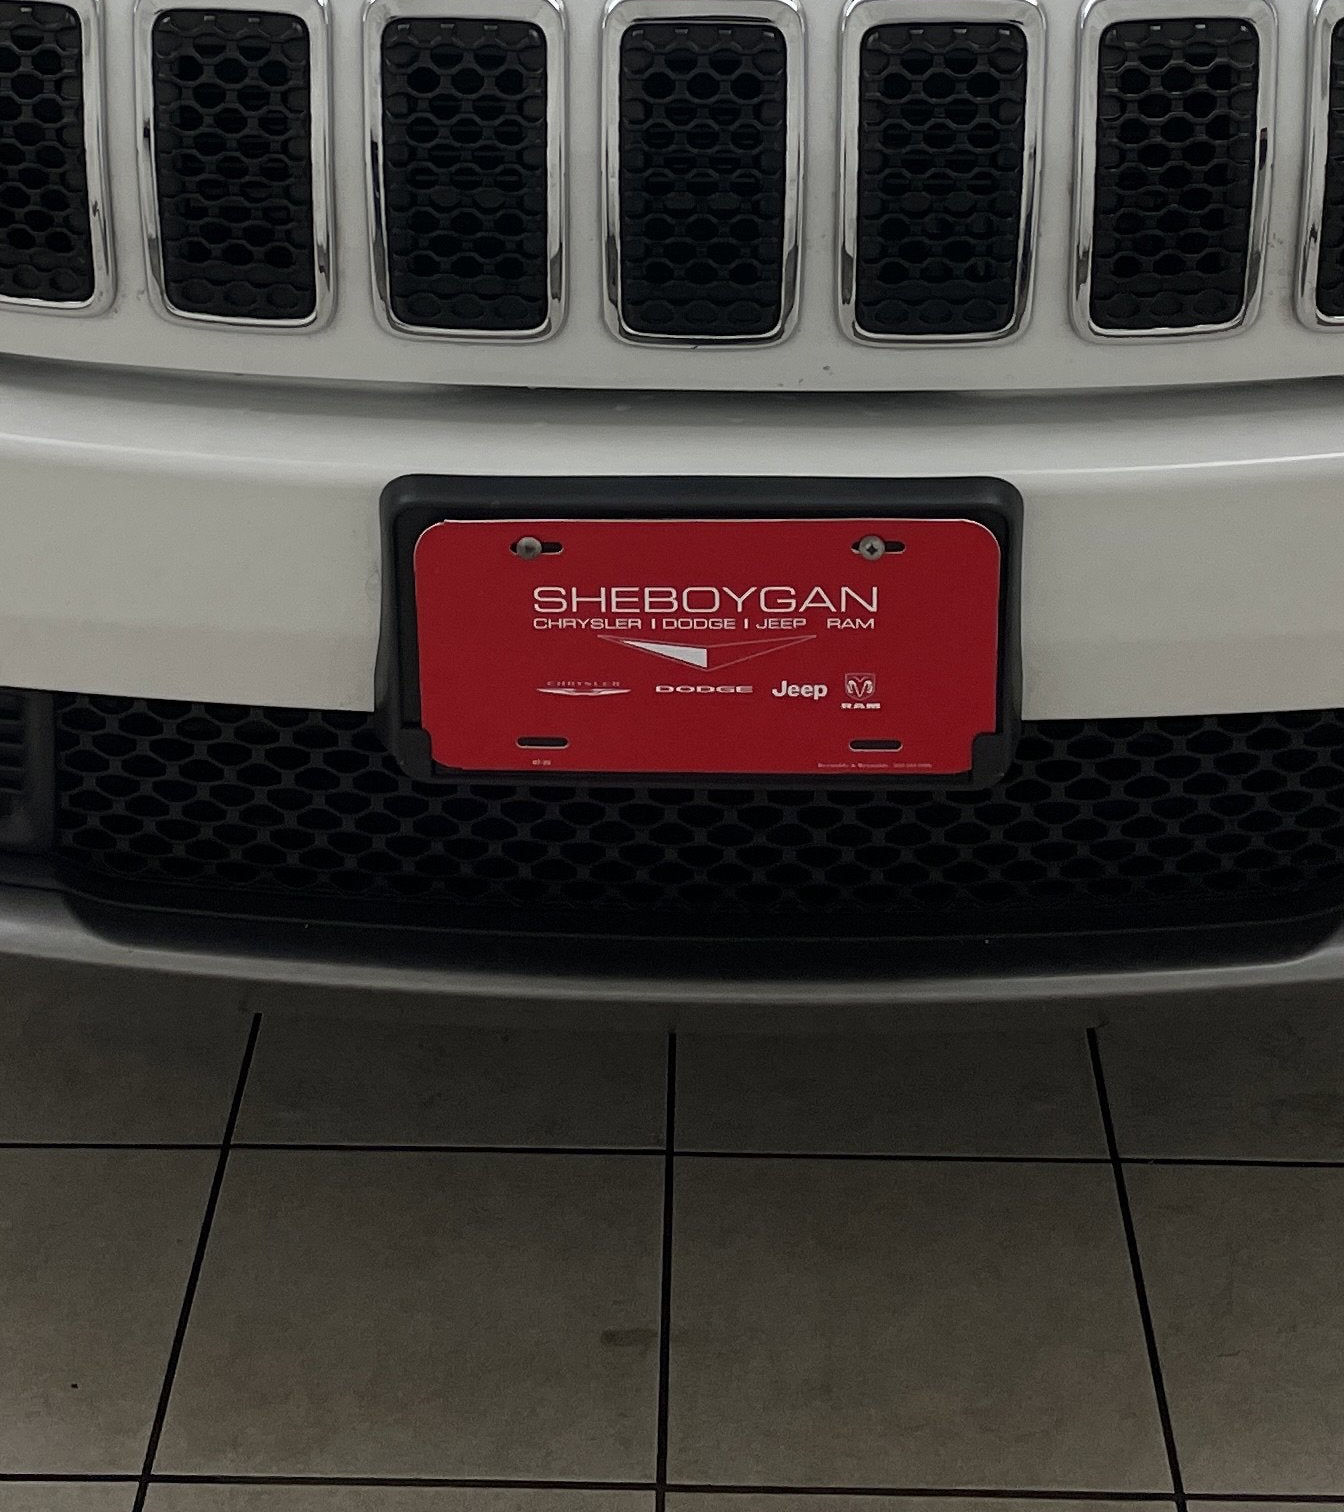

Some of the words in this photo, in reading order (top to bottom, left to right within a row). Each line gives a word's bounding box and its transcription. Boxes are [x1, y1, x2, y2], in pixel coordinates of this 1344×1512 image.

[533, 586, 878, 613] SHEBOYGAN
[533, 617, 642, 631] CHRYSLER
[662, 617, 736, 631] DODGE
[755, 617, 807, 631] JEEP
[827, 617, 875, 631] RAM
[655, 685, 753, 693] DODGE
[771, 680, 828, 700] Jeep
[840, 702, 881, 710] RAM
